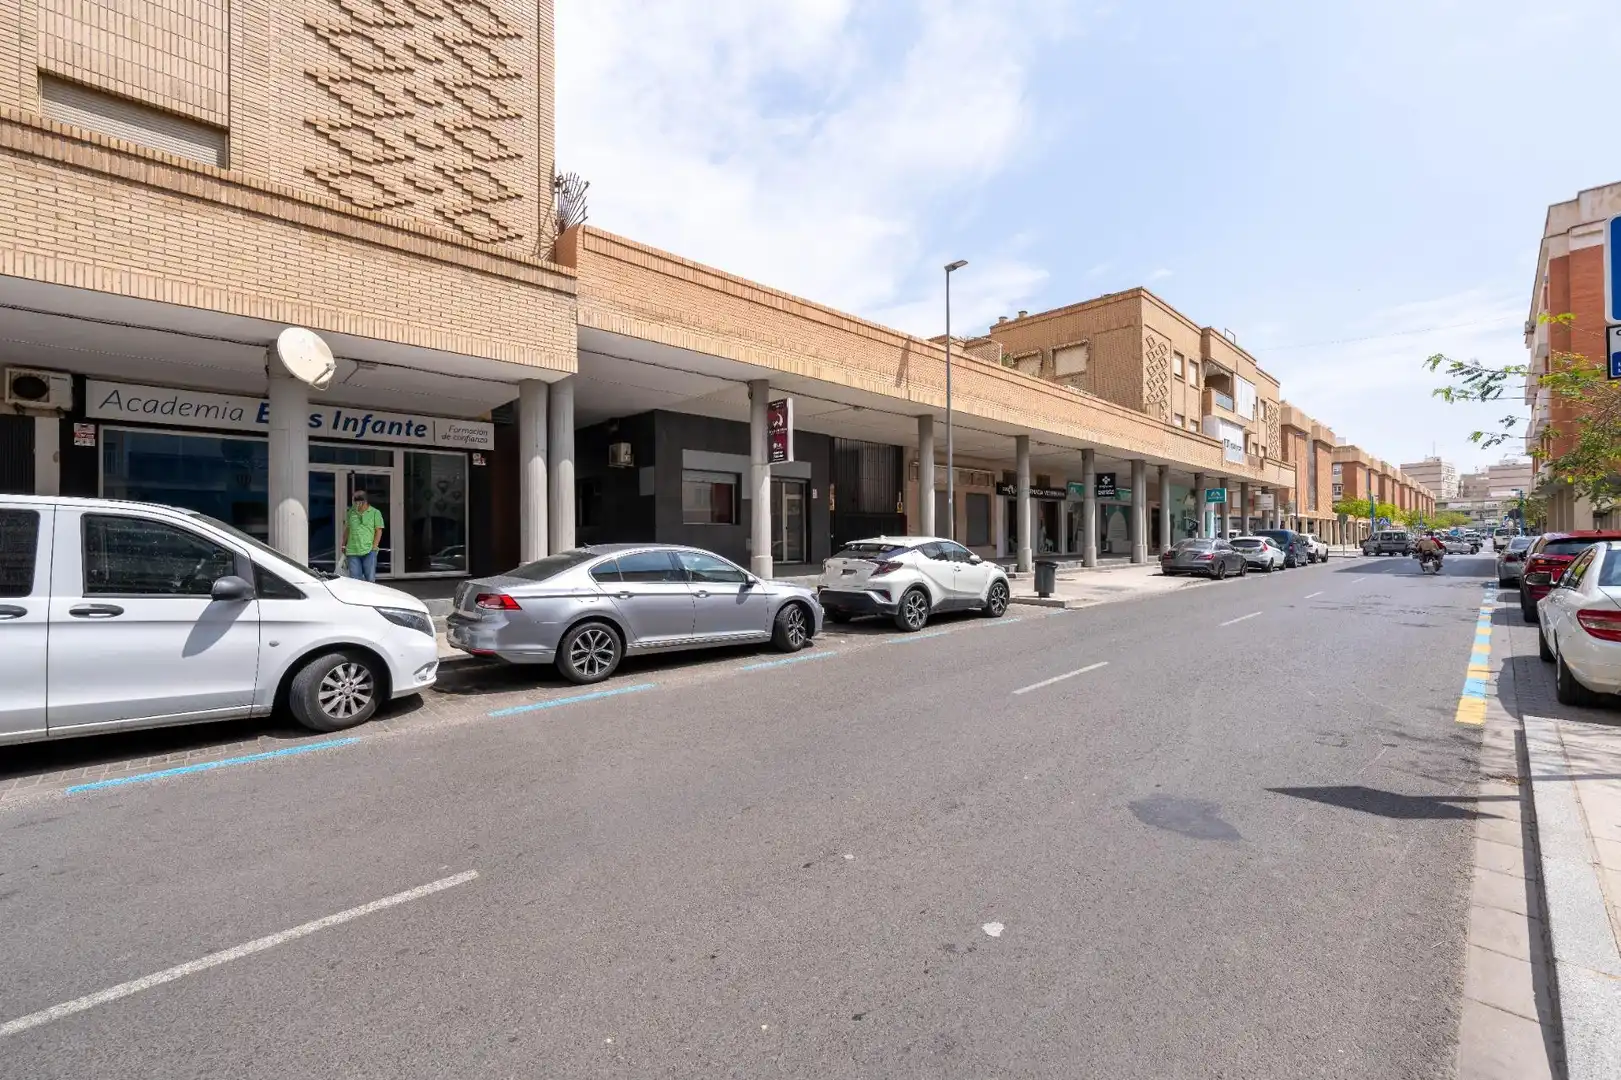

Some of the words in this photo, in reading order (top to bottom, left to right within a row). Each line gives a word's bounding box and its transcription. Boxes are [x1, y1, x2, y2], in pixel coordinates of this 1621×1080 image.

[98, 389, 245, 422] Academia
[331, 409, 428, 438] Infante
[441, 432, 451, 441] de
[452, 434, 488, 444] confianza
